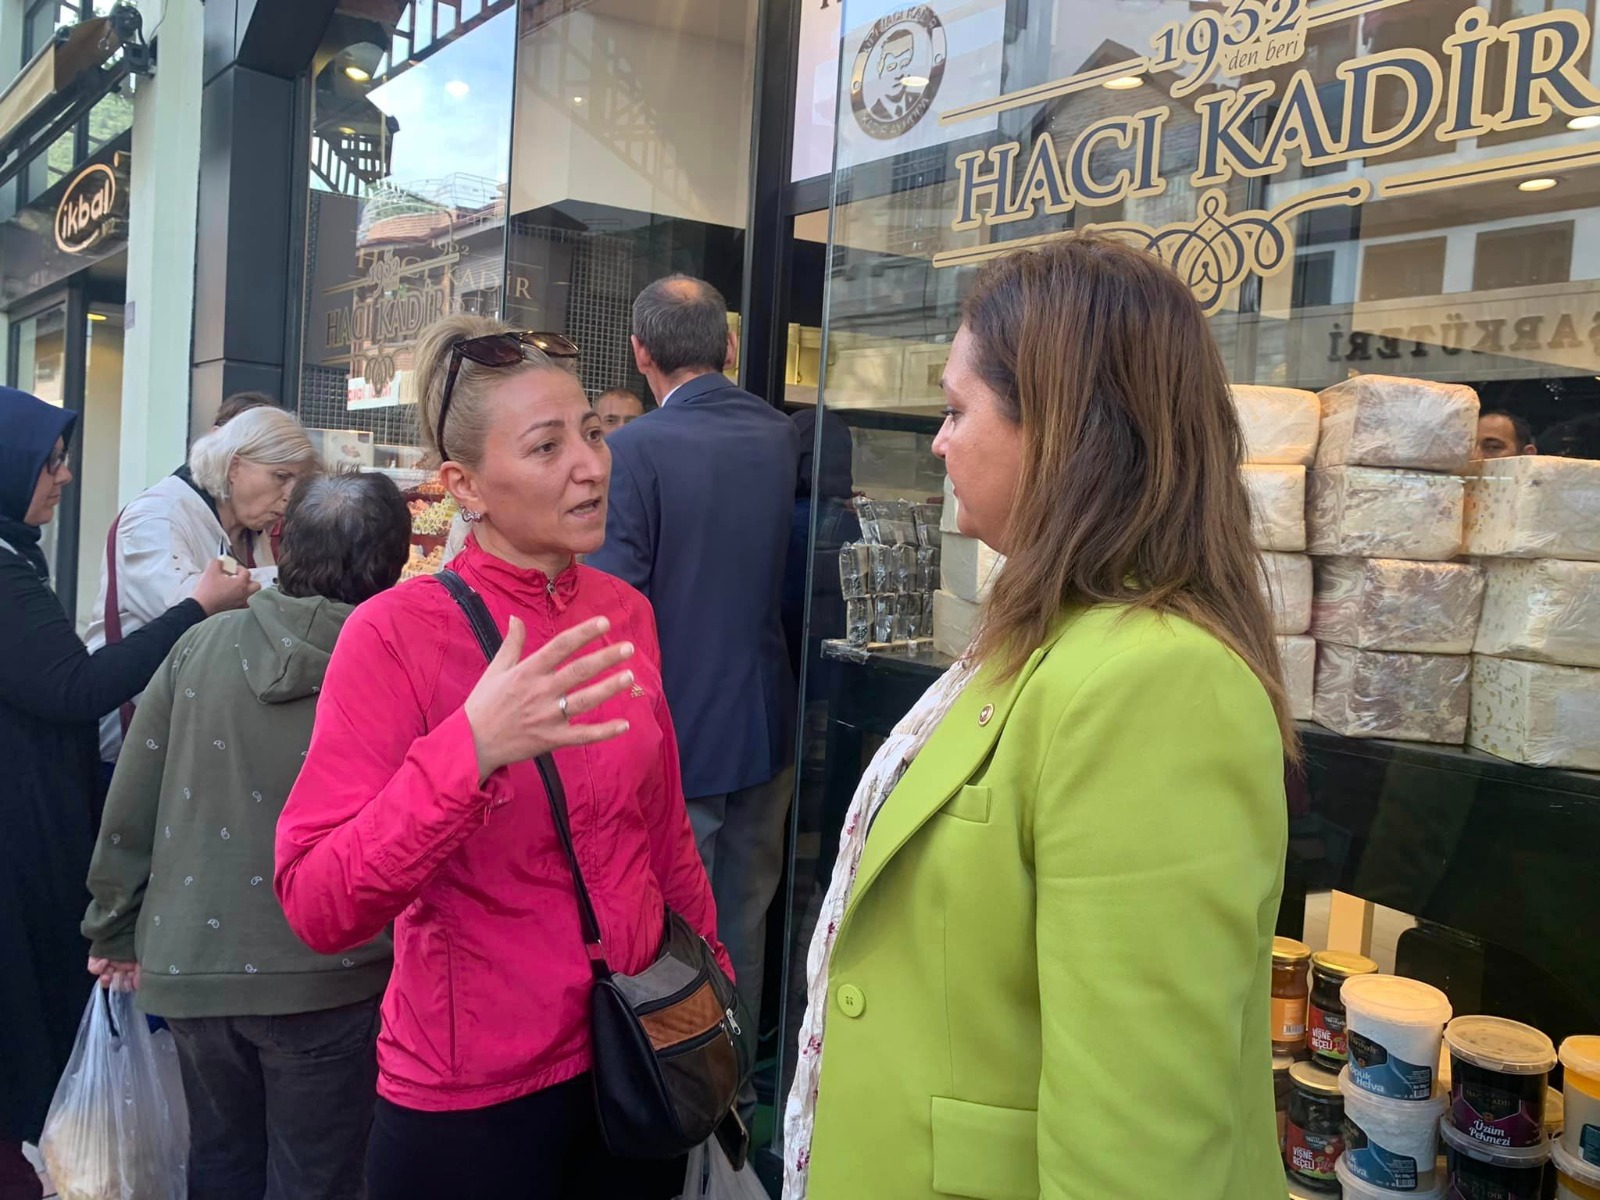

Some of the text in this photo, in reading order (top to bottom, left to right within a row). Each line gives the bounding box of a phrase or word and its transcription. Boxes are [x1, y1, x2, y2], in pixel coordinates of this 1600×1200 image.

[1154, 0, 1302, 91] 1952
[1265, 33, 1300, 61] beri
[954, 13, 1600, 227] HACI KADİR
[61, 178, 109, 240] ikbal
[326, 278, 445, 347] HACI KADİR
[1356, 1076, 1385, 1093] Helva
[1468, 1126, 1511, 1147] Pekmezi
[1473, 1118, 1505, 1137] Üzüm
